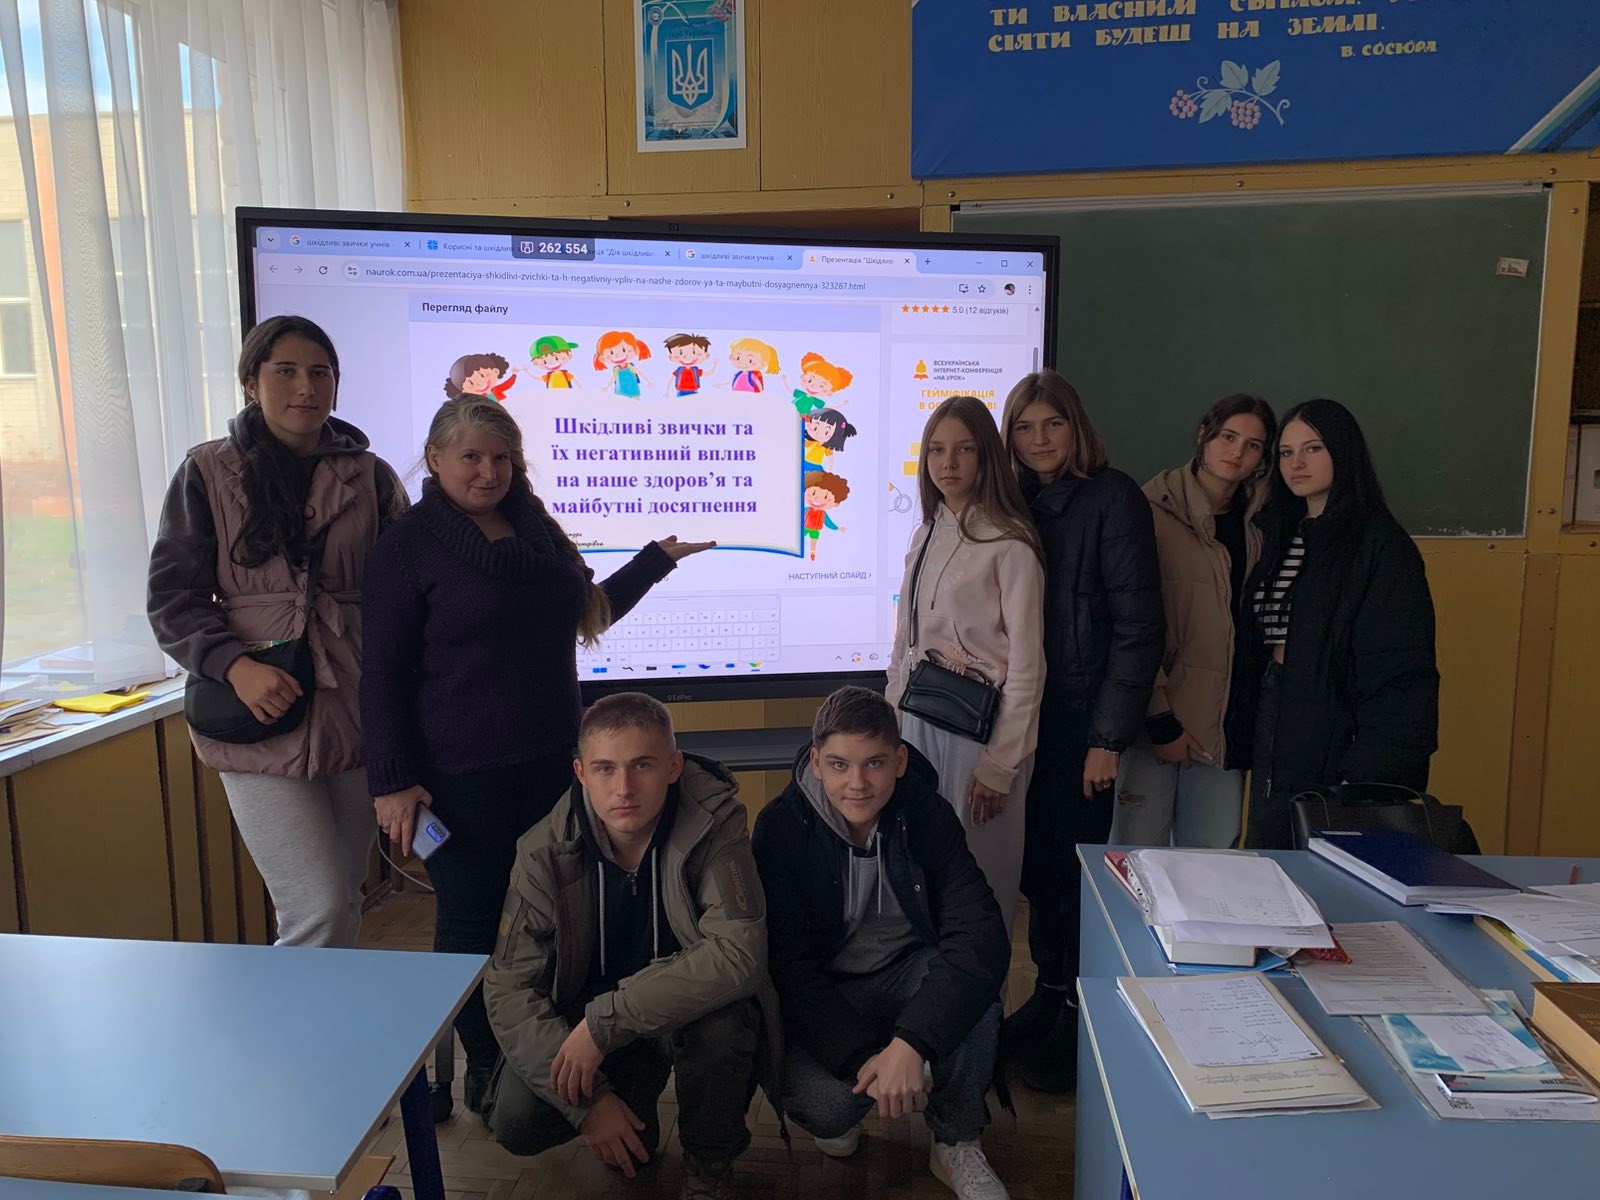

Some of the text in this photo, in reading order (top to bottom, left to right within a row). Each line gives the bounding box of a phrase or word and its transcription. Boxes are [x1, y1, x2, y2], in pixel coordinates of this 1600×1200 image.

[990, 8, 1028, 26] ТИ
[1053, 0, 1197, 23] ВЛАСНИМ
[988, 31, 1071, 53] СІЯТИ
[1095, 24, 1191, 46] БУДЕШ
[1217, 20, 1260, 39] НА
[1361, 40, 1437, 56] СОСЮРА
[539, 242, 588, 255] 262 554
[422, 302, 508, 316] Перегляд файлу
[555, 417, 754, 436] Шкідливі звички та
[551, 444, 756, 462] їх негативний вплив
[556, 475, 579, 487] на
[586, 475, 638, 487] наше
[732, 475, 753, 487] та
[552, 498, 757, 518] майбутні досягнення
[788, 571, 867, 580] НАСТУПНИЙ СЛАЙД
